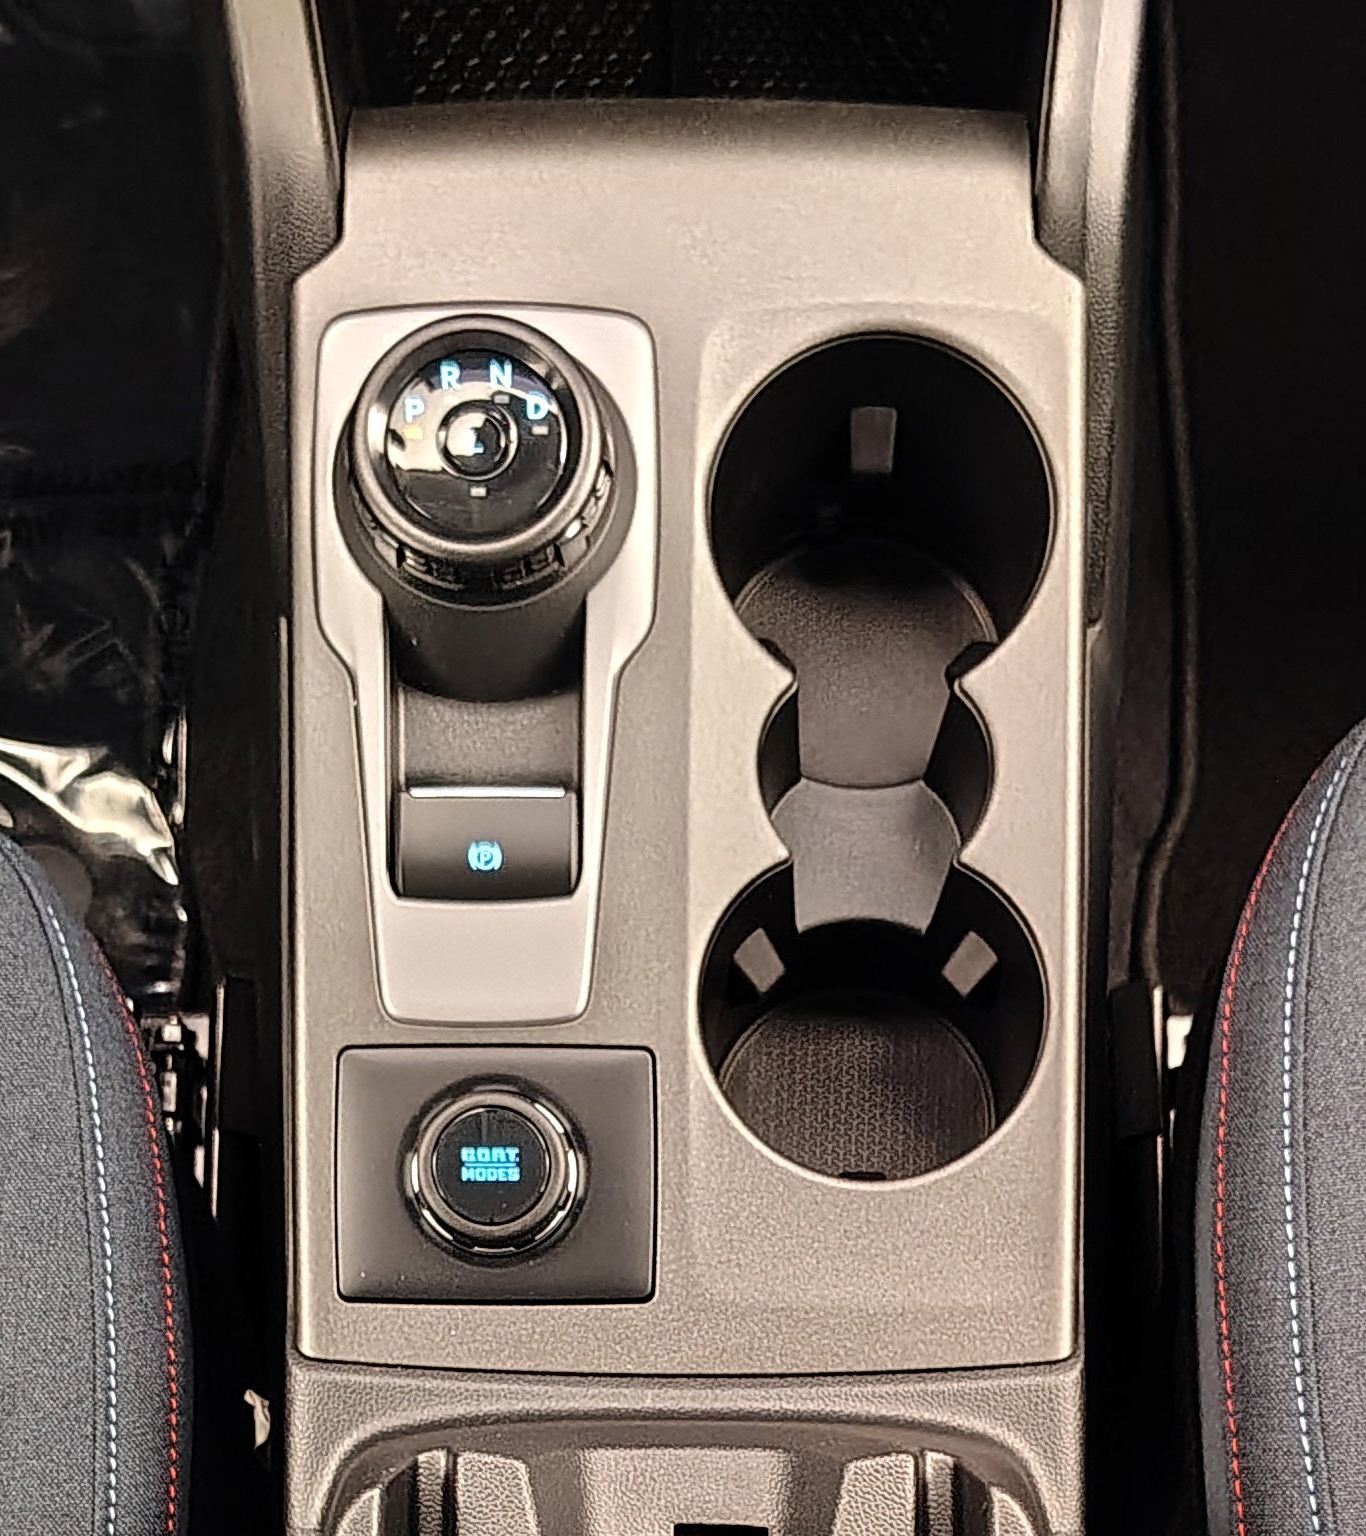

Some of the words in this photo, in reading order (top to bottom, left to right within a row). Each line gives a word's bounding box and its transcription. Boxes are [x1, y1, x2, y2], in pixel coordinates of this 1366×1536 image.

[403, 397, 425, 424] P
[439, 360, 461, 389] R
[489, 358, 513, 388] N
[526, 391, 550, 420] D
[460, 1166, 521, 1182] MODES
